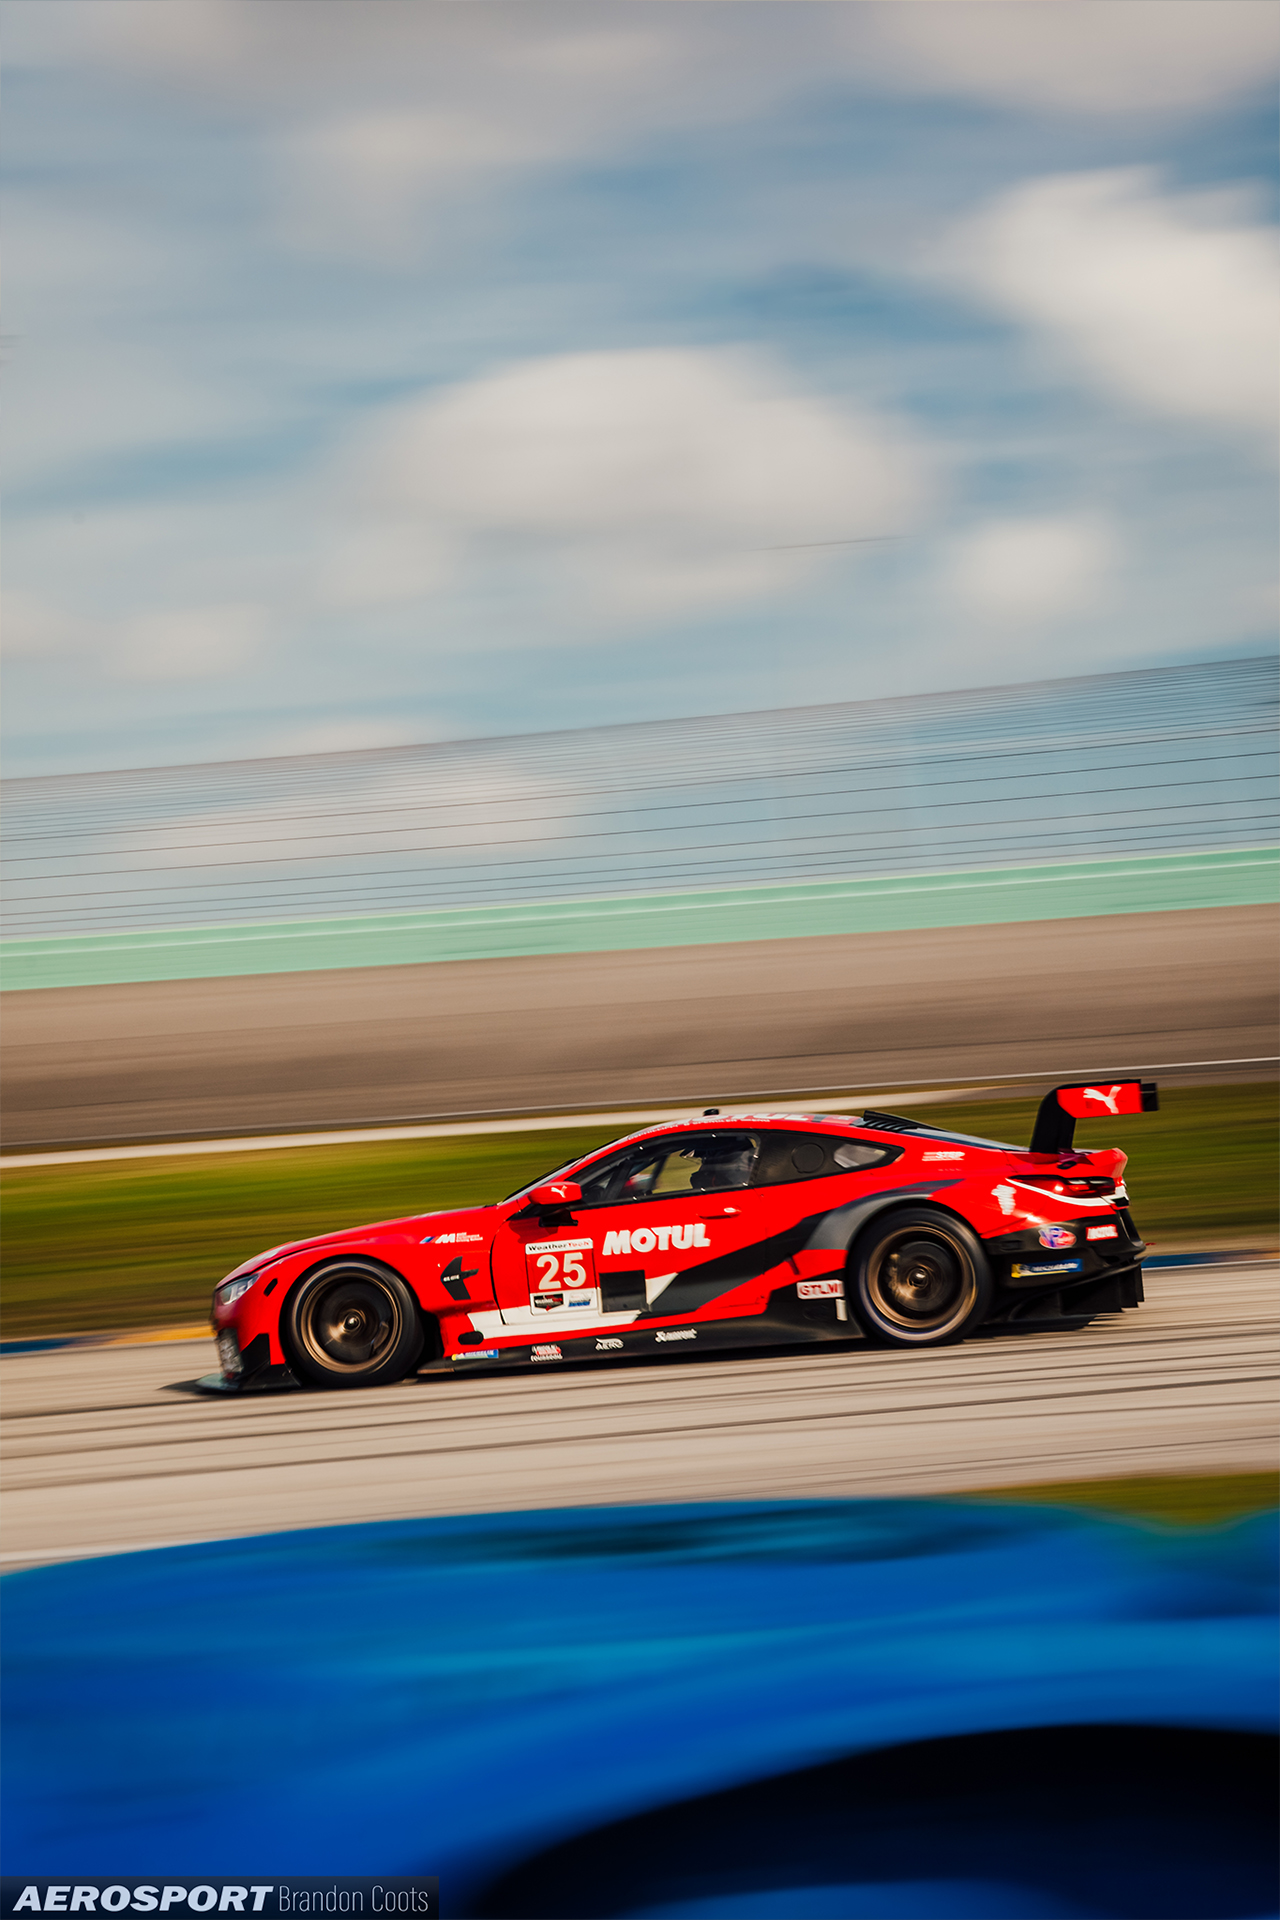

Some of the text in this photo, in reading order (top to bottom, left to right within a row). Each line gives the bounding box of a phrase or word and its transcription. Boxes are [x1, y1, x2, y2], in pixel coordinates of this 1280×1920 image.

[528, 1241, 590, 1251] WeatherTech
[602, 1223, 711, 1256] MOTUL
[536, 1252, 587, 1290] 25
[799, 1283, 843, 1296] GTLM
